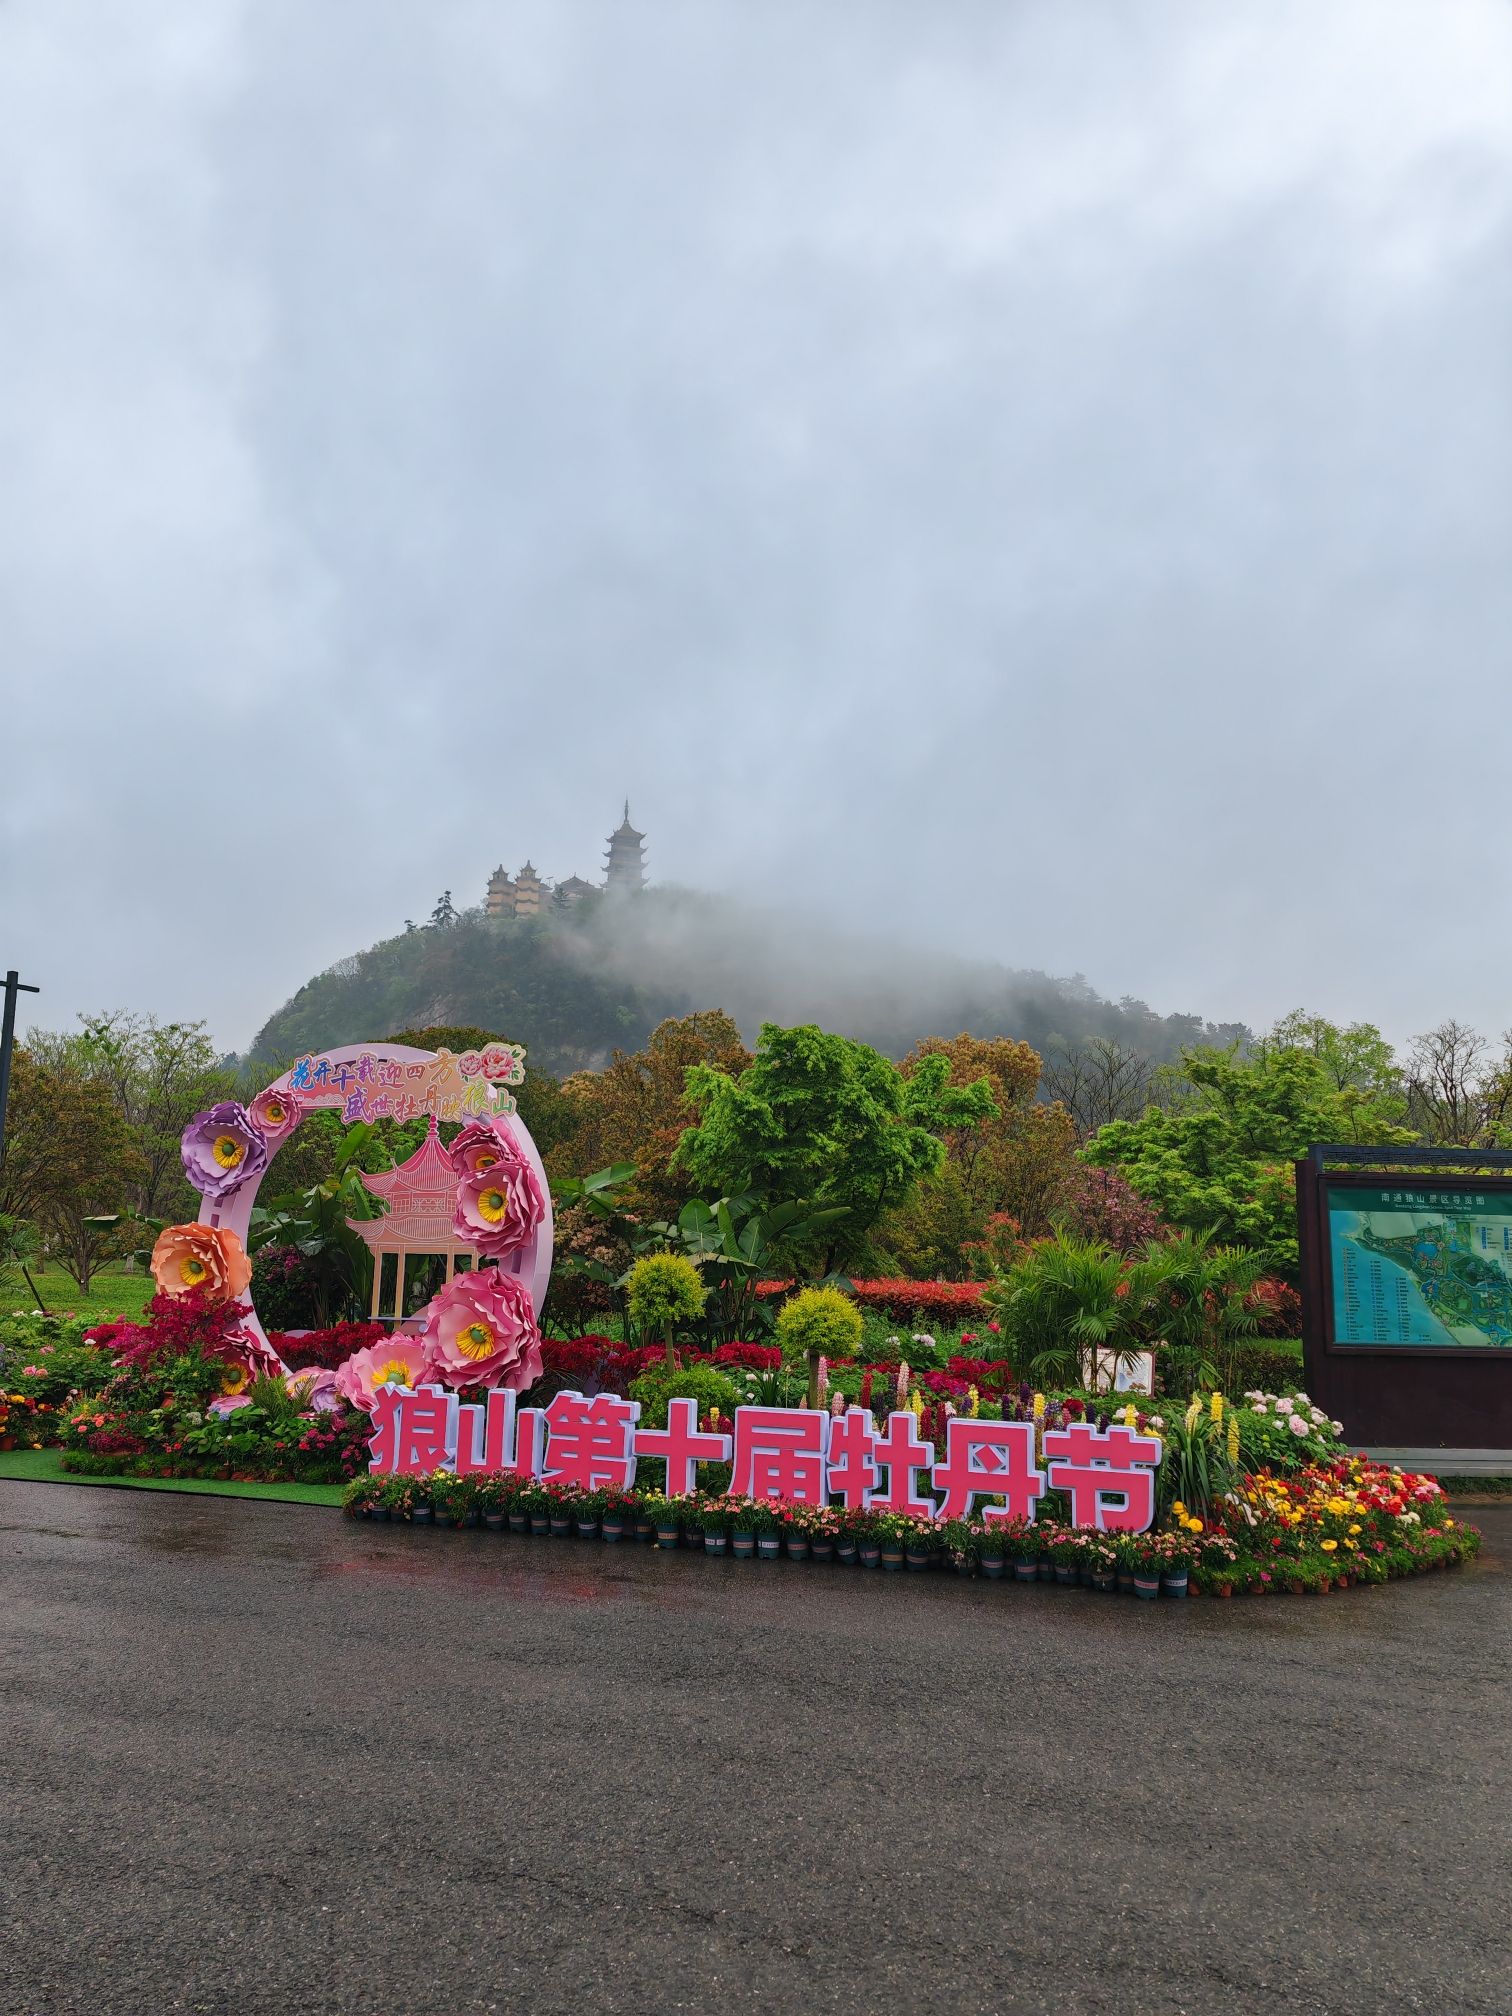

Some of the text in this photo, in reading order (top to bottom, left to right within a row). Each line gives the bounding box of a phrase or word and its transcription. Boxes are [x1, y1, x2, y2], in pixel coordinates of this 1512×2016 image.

[290, 1051, 458, 1092] 花开十载迎四方
[344, 1081, 514, 1122] 盛世牡丹映狼山
[367, 1382, 1163, 1534] 狼山第十届牡丹节
